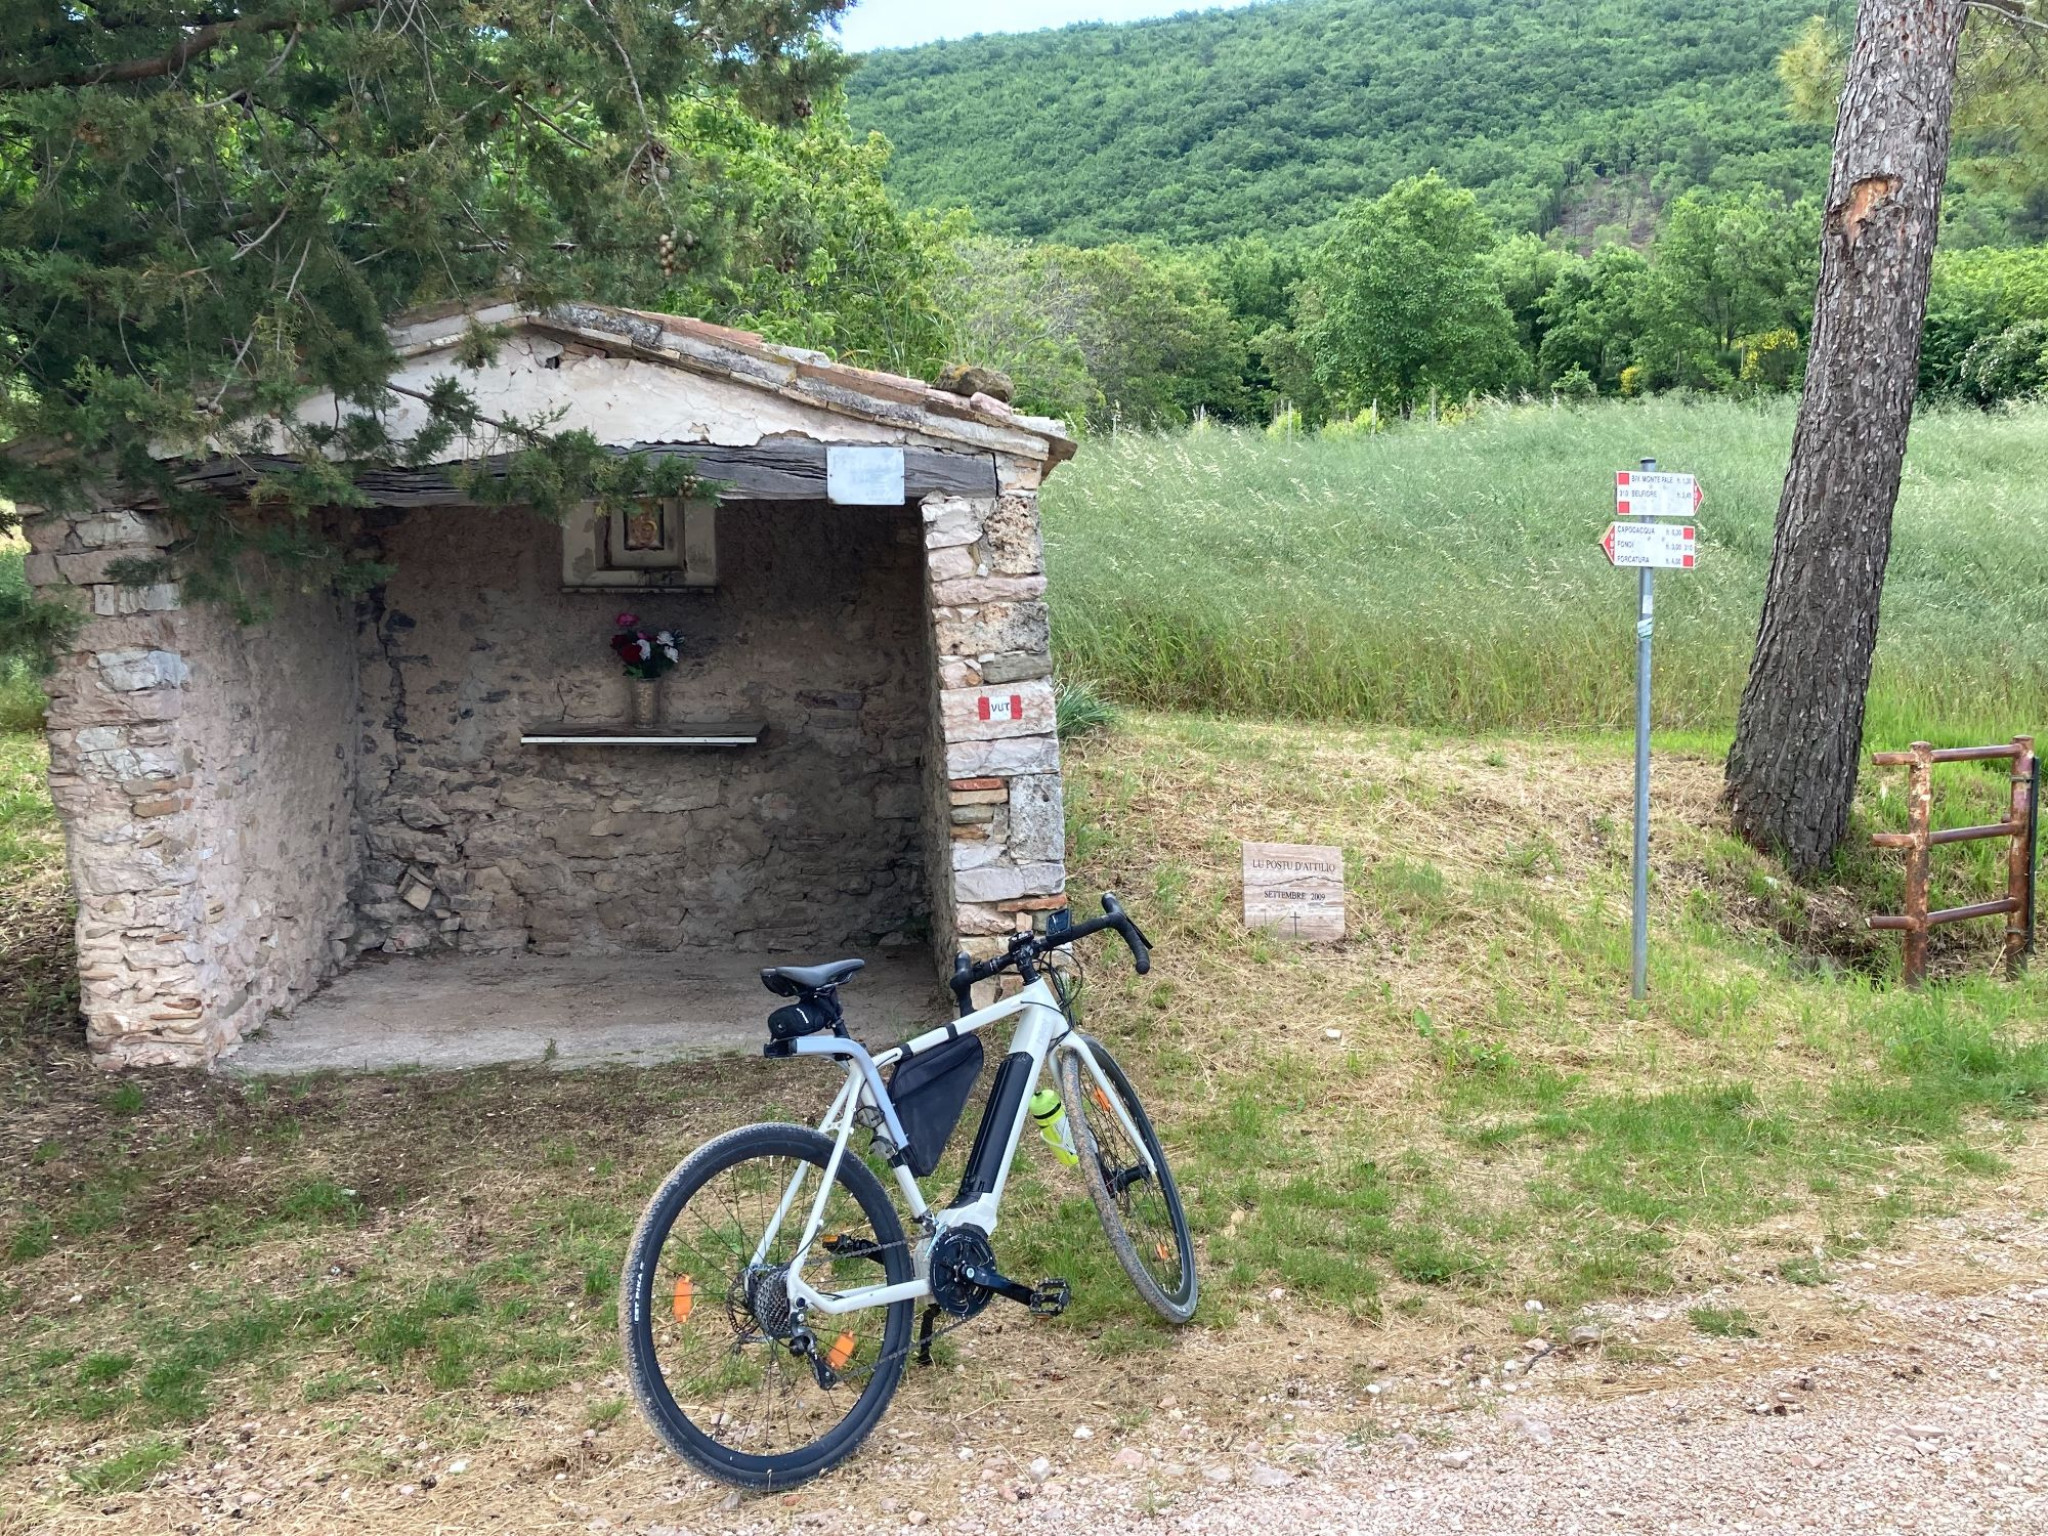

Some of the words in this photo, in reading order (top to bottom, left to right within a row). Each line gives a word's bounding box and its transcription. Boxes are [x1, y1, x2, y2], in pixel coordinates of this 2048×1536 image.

[1618, 526, 1655, 535] CAPODACQUA
[991, 702, 1010, 712] VUT
[1266, 860, 1293, 870] POSTU
[1295, 862, 1336, 872] D'ATTILIO
[1264, 891, 1306, 900] SETTEMBRE
